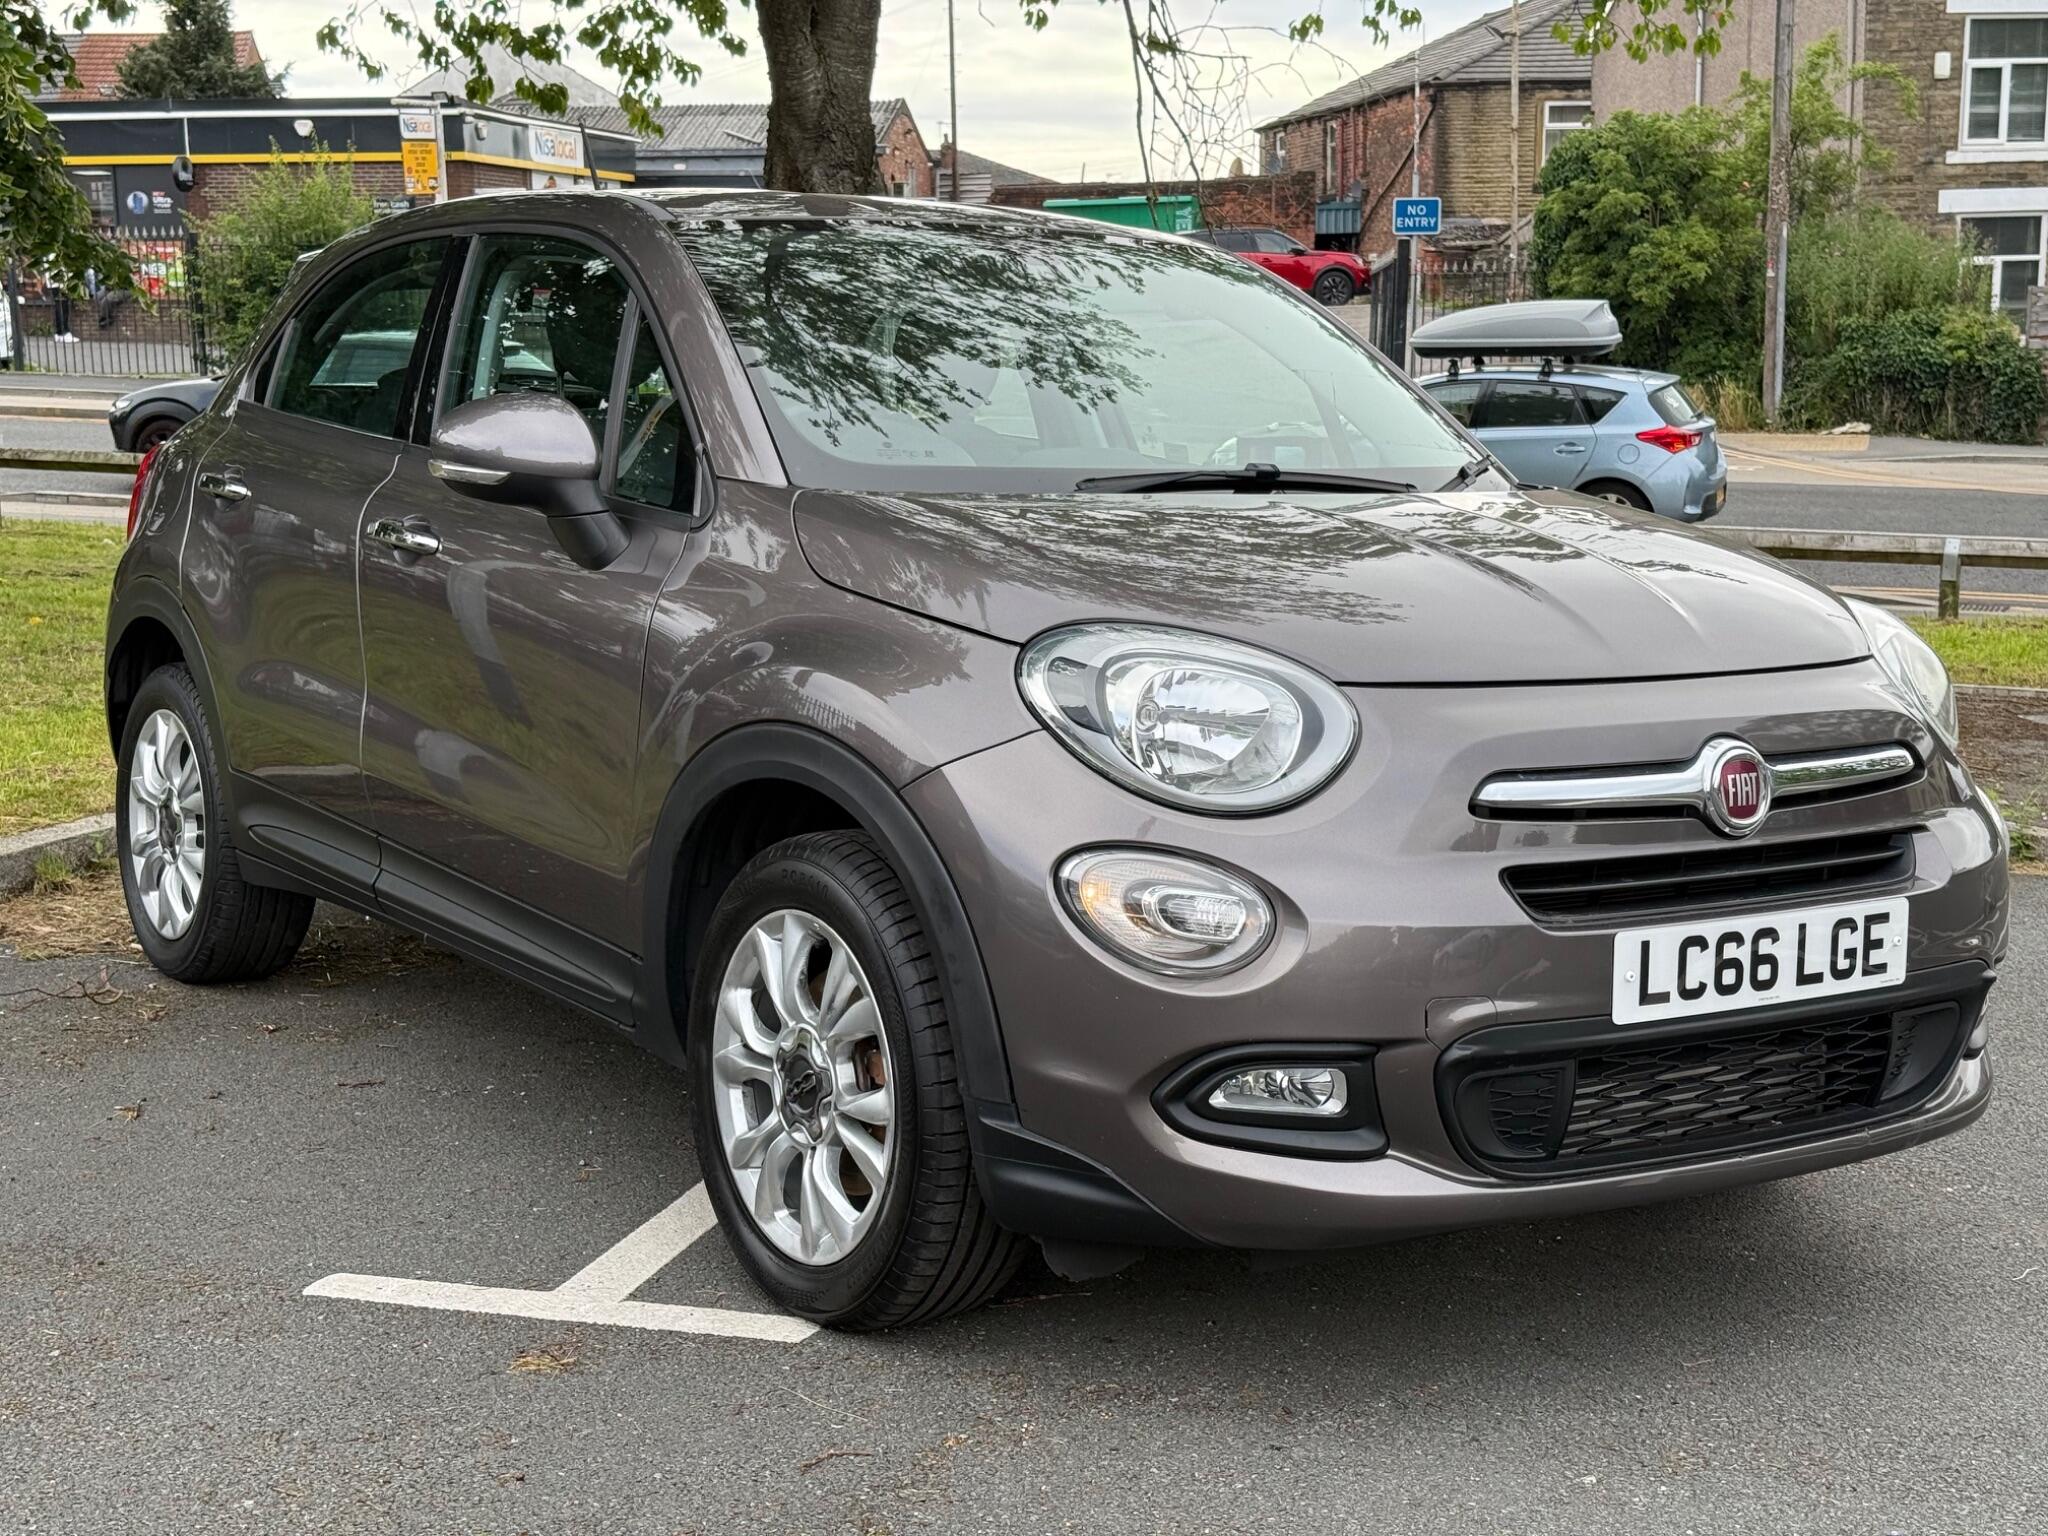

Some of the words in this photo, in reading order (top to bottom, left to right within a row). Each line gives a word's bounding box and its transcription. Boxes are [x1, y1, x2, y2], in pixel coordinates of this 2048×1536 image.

[1396, 216, 1437, 228] ENTRY
[1407, 204, 1427, 216] NO
[1727, 772, 1758, 808] FIAT
[1638, 926, 1780, 1007] LC66
[1795, 911, 1891, 987] LGE
